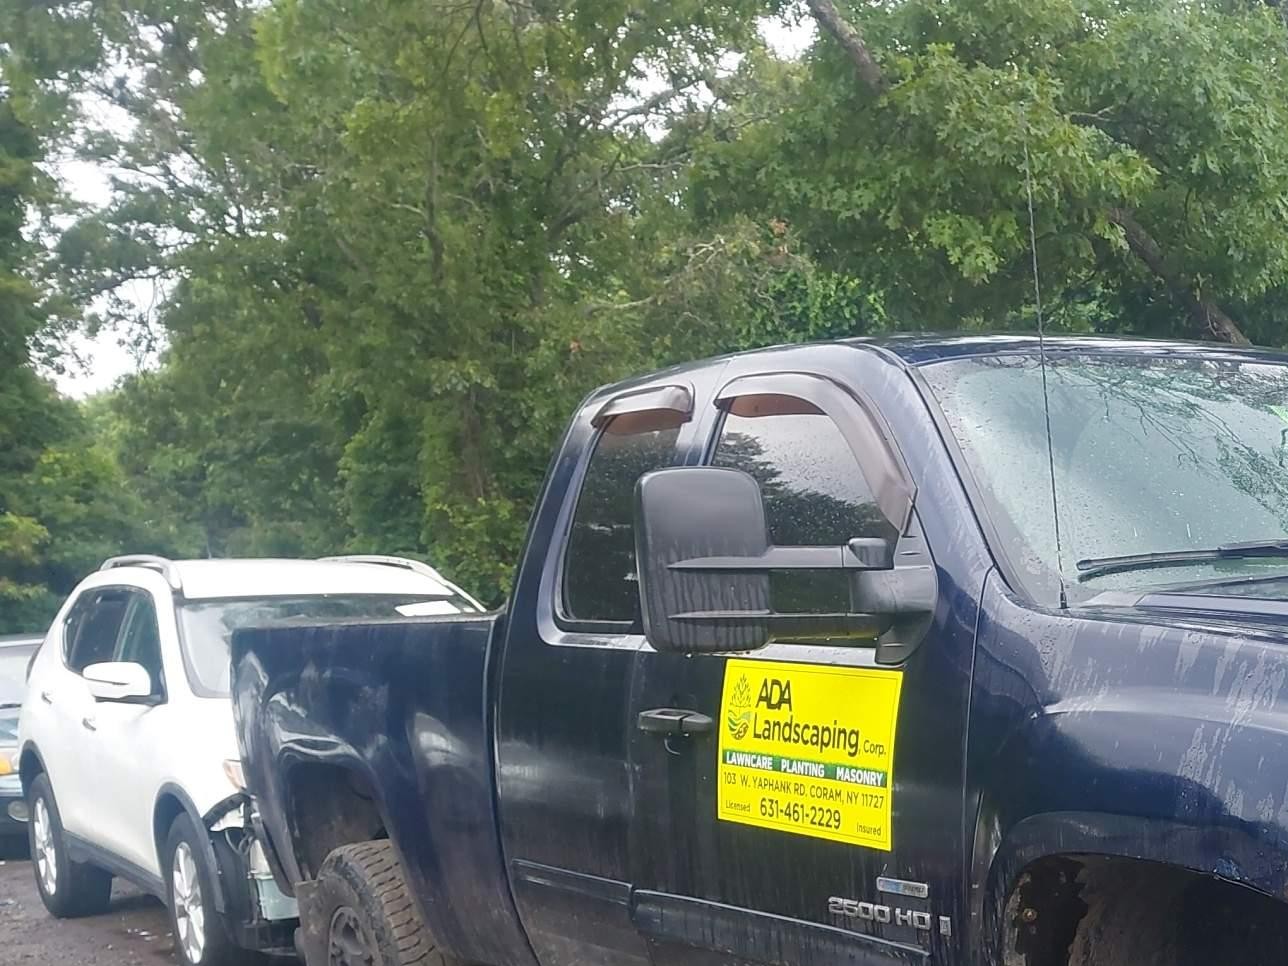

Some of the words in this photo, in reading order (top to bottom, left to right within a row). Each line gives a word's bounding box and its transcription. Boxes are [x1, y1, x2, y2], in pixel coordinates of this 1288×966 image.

[755, 678, 793, 712] ADA
[863, 740, 887, 756] Corp.
[726, 755, 773, 770] LAWNCARE
[780, 759, 825, 778] PLANTING
[836, 766, 884, 786] MASONRY
[724, 771, 736, 785] 103
[740, 774, 751, 787] W.
[752, 776, 792, 794] YAPHANK
[809, 784, 844, 804] CORAM,
[846, 790, 861, 804] NY
[862, 793, 884, 809] 11727
[725, 799, 751, 812] Licensed
[760, 797, 841, 830] 631-461-2229
[856, 822, 882, 836] Insured
[828, 896, 890, 924] 2500
[895, 907, 931, 930] HD
